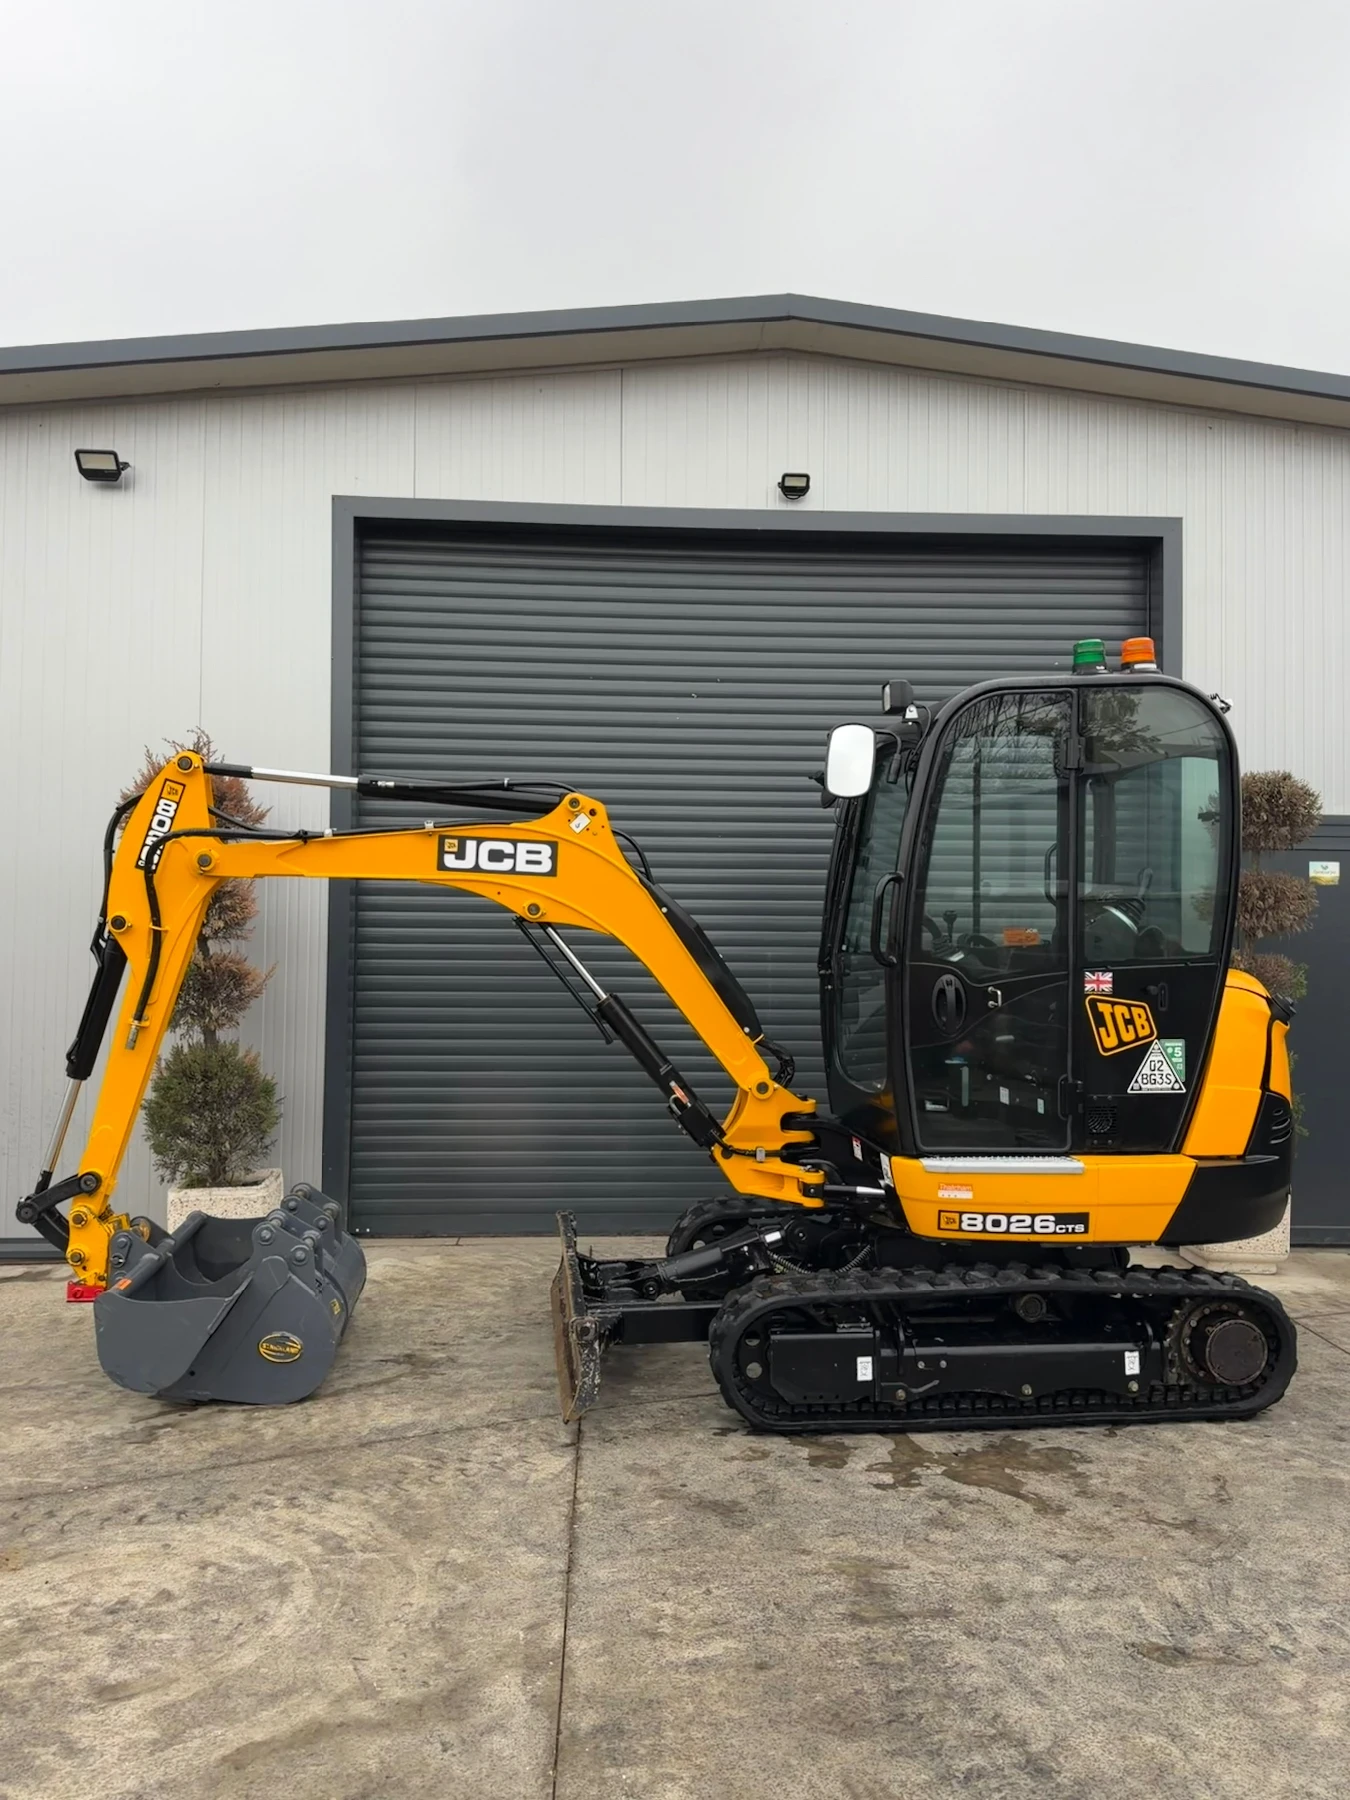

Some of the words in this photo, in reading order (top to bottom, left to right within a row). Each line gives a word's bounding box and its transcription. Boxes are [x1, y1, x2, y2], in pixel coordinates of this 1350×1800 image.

[443, 839, 553, 874] JCB
[1096, 1001, 1151, 1049] JCB
[1174, 1046, 1182, 1058] 5
[1141, 1073, 1172, 1086] BG3S
